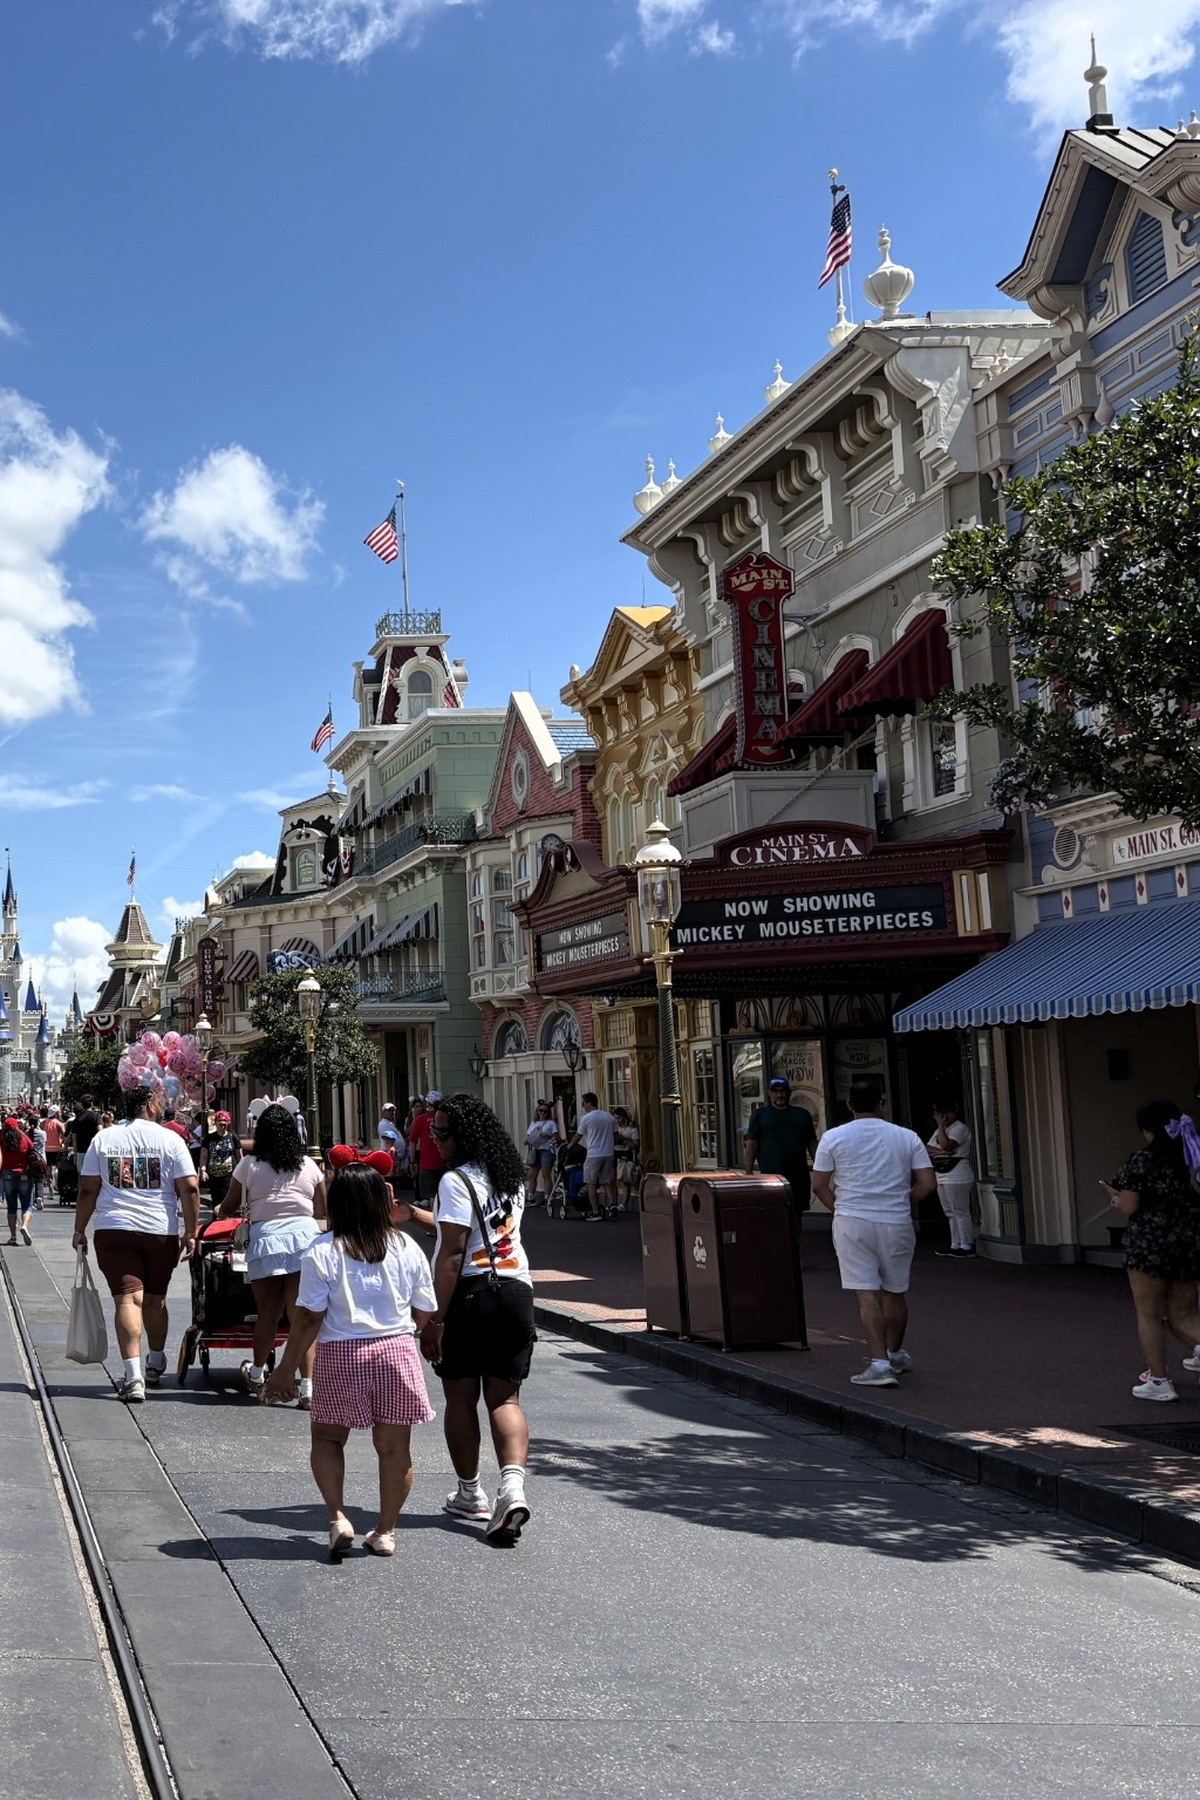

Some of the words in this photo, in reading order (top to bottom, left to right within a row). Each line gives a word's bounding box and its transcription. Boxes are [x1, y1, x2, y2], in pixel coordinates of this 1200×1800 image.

[730, 568, 783, 588] MAIN
[762, 579, 789, 590] ST.
[748, 596, 784, 740] CINEMA
[730, 837, 864, 866] CINEMA
[761, 834, 804, 847] MAIN
[809, 832, 829, 845] ST.
[1127, 831, 1158, 858] MAIN
[1160, 827, 1177, 851] ST.
[724, 900, 769, 918] NOW
[783, 892, 876, 914] SHOWING
[559, 931, 572, 944] NOW
[575, 921, 602, 940] SHOWING
[677, 924, 745, 943] MICKEY
[759, 911, 934, 938] MOUSETERPIECES
